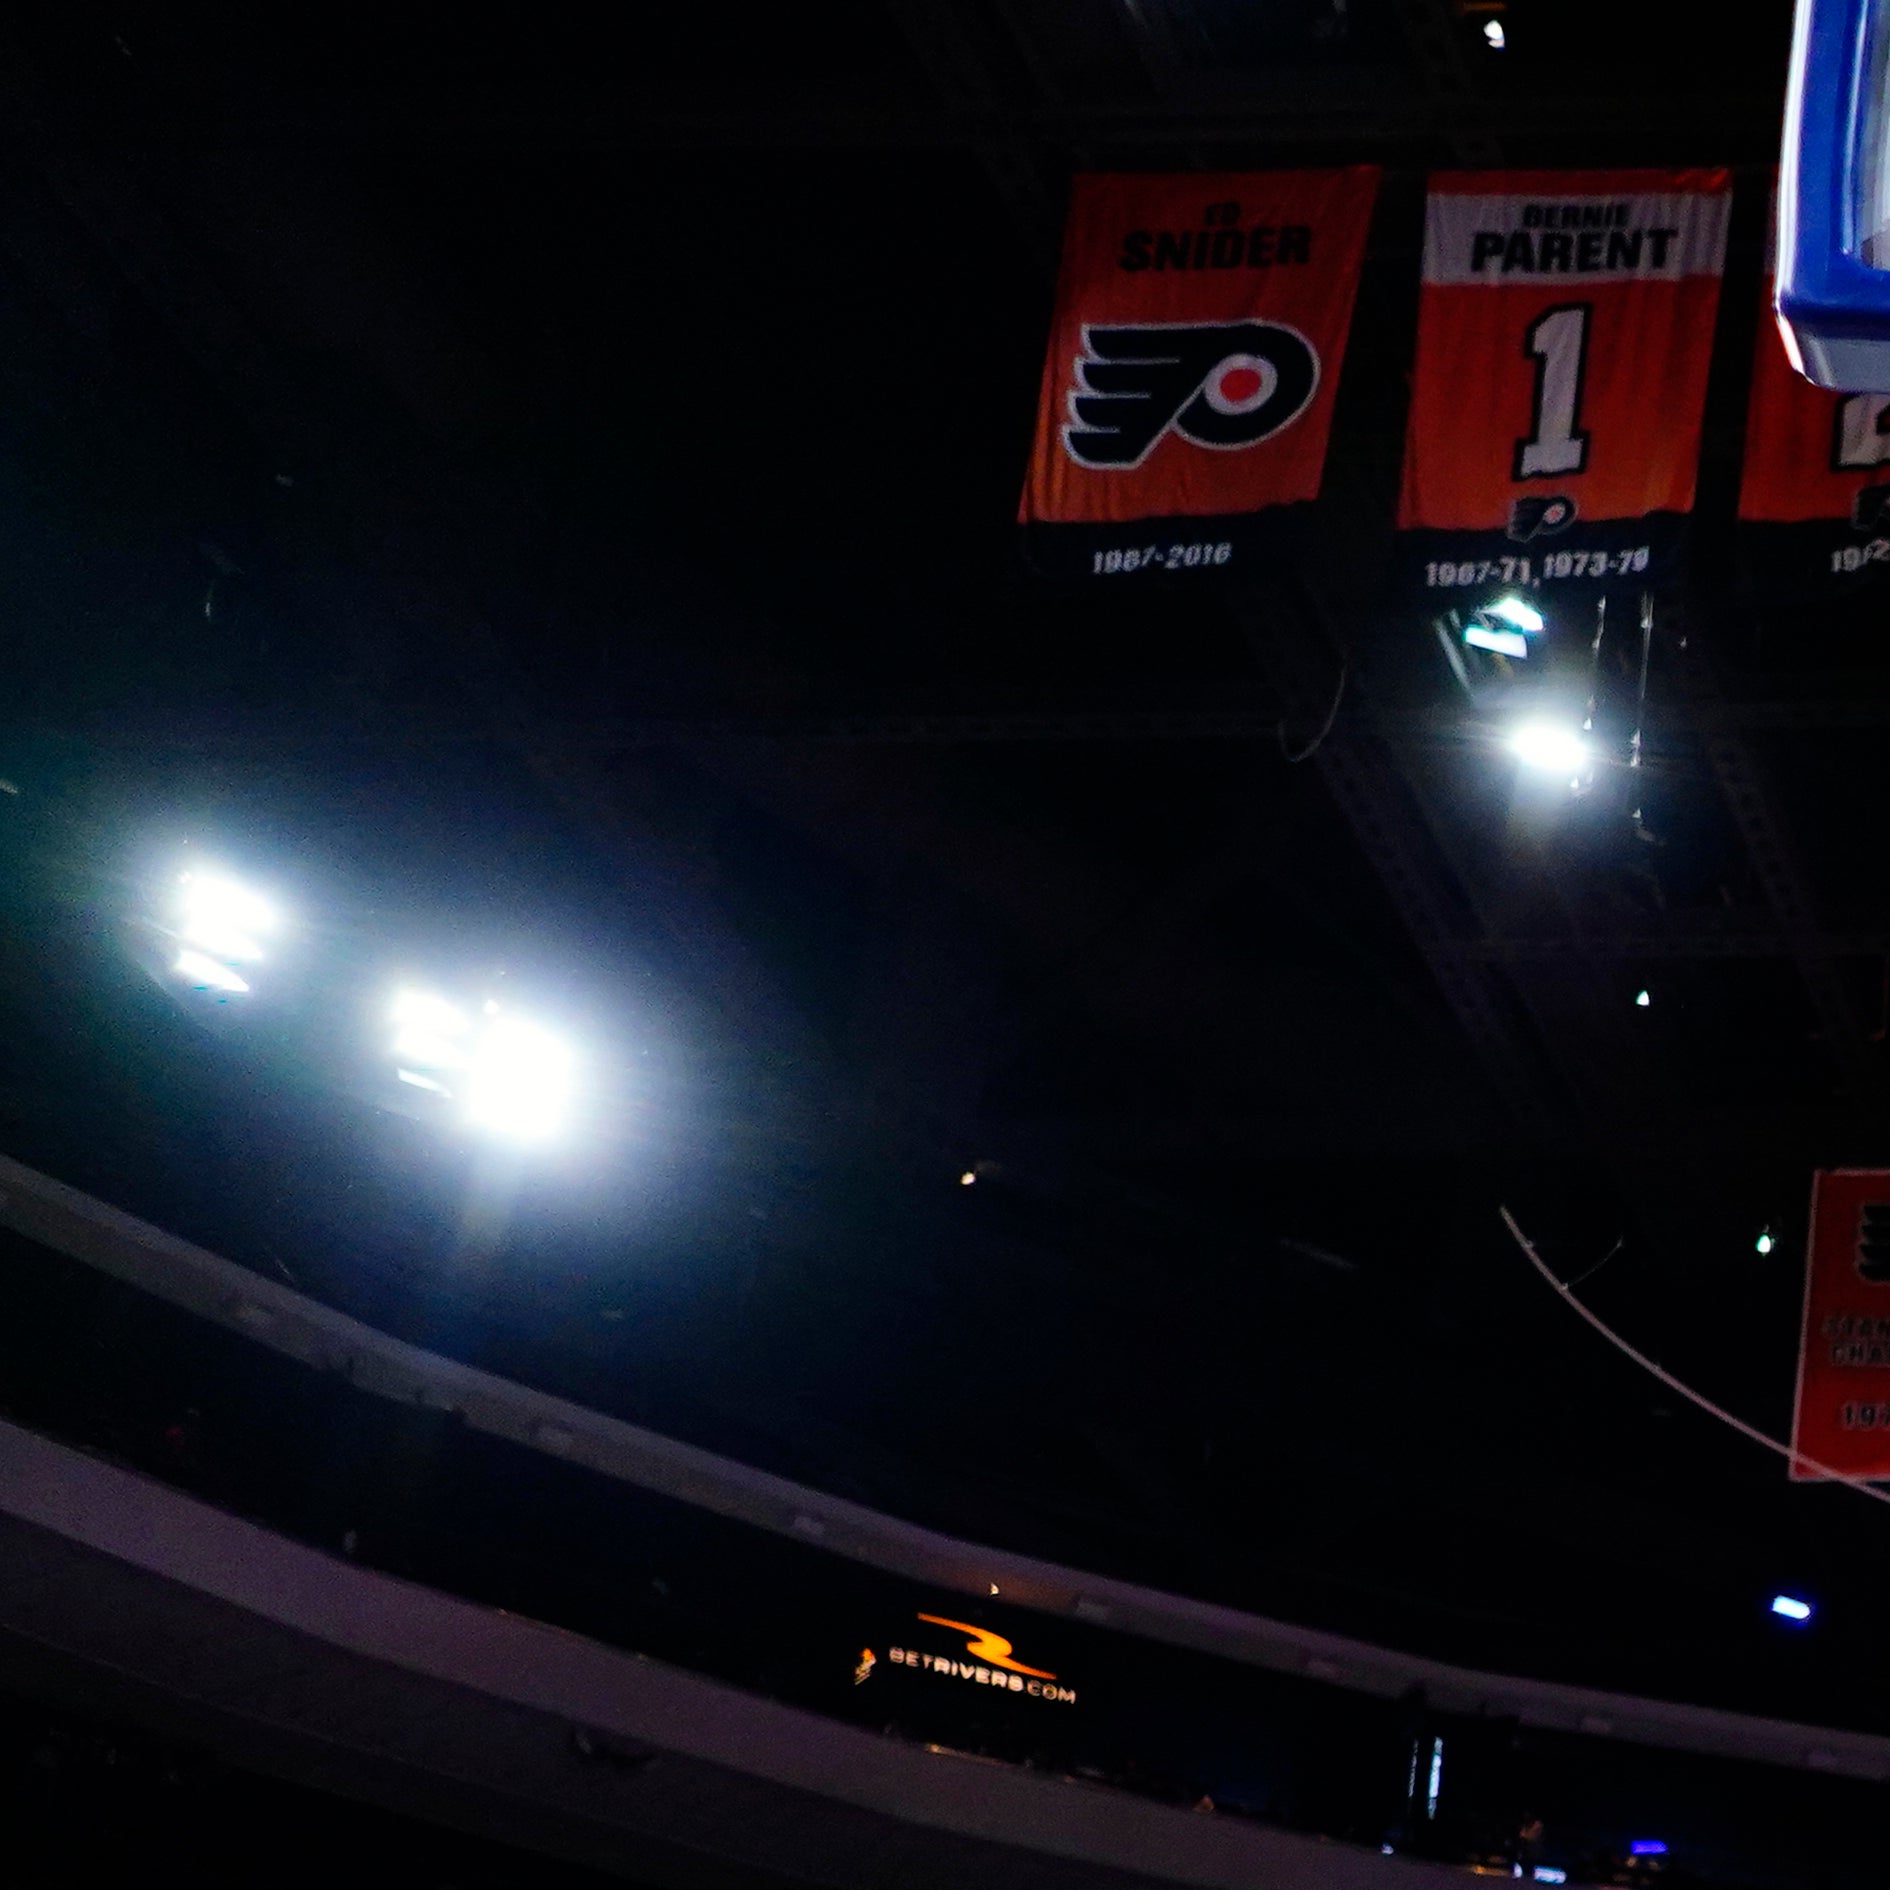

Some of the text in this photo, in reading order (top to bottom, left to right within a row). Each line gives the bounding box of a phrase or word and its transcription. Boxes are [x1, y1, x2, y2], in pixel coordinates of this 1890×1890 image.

[1119, 226, 1312, 271] SNIDER
[1469, 228, 1679, 274] PARENT
[1512, 302, 1589, 481] 1
[889, 1646, 1076, 1704] BETRIVERS.COM
